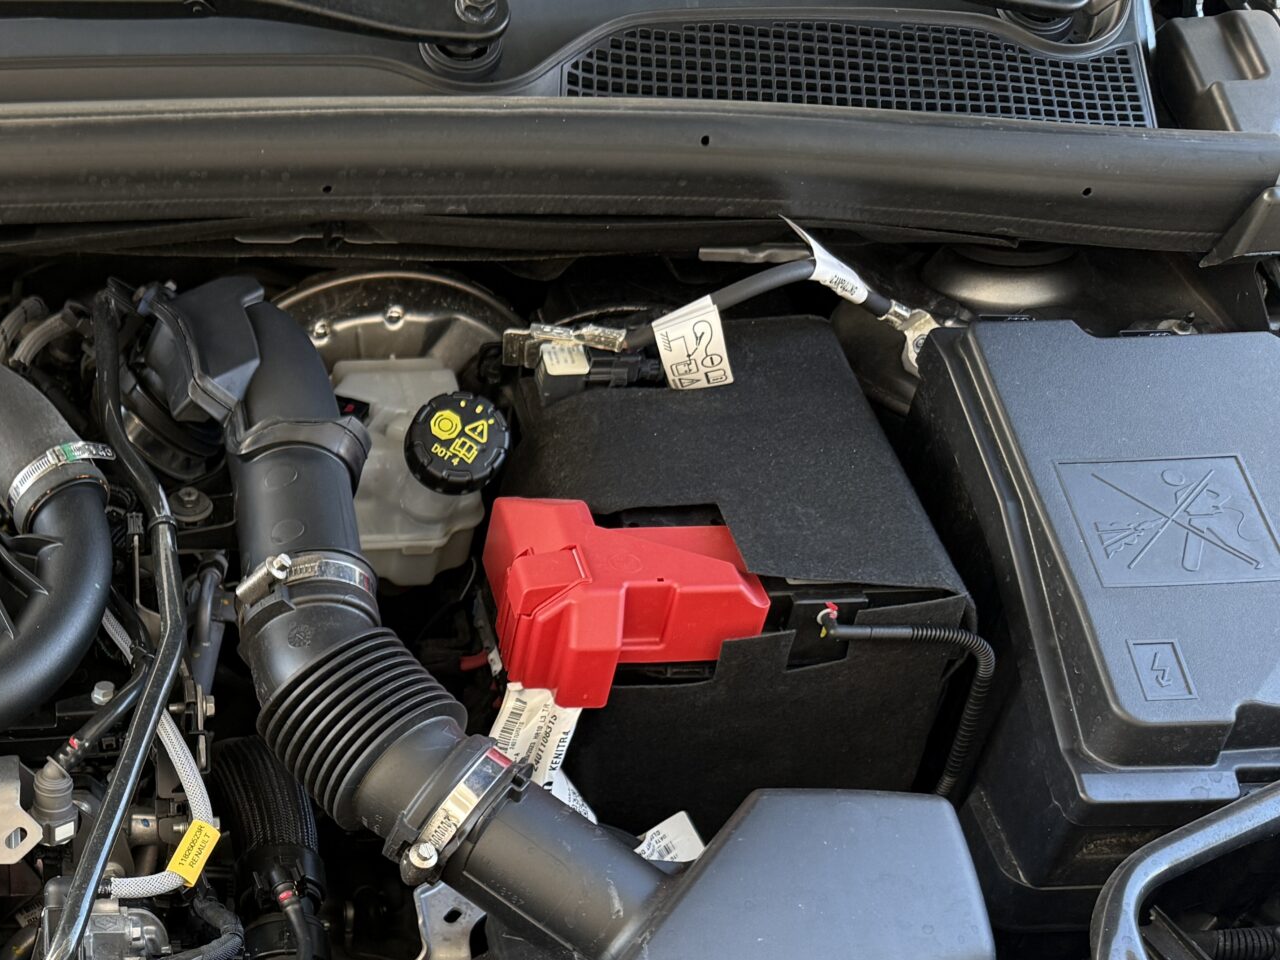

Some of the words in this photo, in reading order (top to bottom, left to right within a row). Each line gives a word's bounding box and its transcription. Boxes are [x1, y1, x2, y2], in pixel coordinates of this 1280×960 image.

[431, 443, 452, 459] DOT
[451, 457, 460, 466] 4
[549, 730, 570, 771] KENITRA
[189, 833, 210, 868] RENAULT
